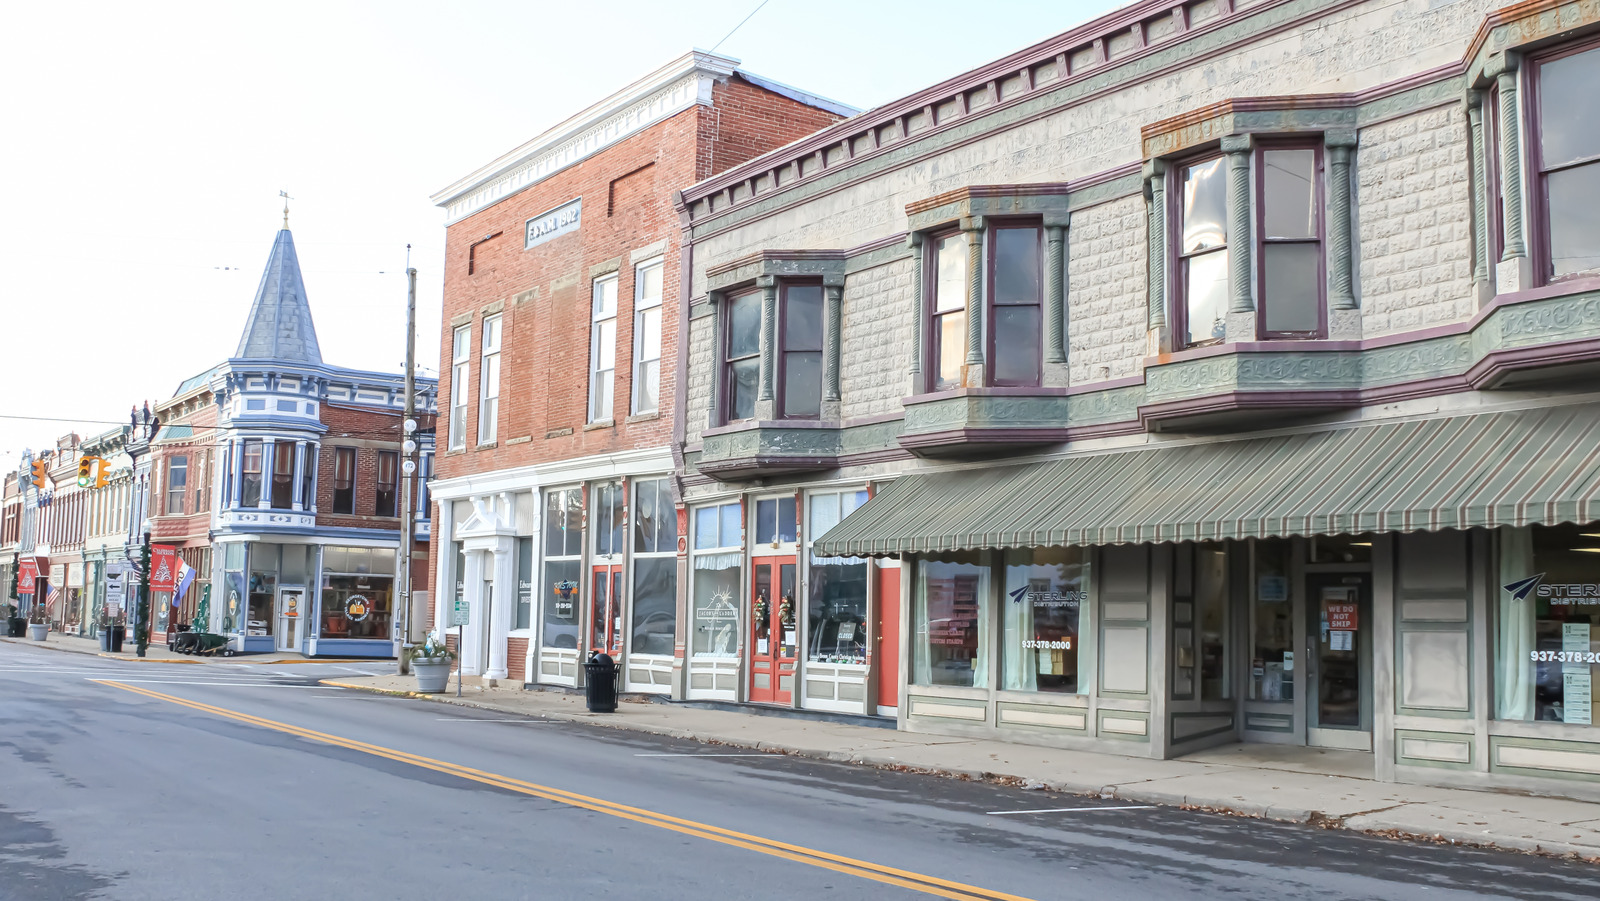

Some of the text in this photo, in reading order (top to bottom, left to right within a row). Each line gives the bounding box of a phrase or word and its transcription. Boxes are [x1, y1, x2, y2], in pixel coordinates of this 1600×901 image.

[1536, 583, 1600, 597] STER
[1026, 591, 1089, 601] STERLING
[1550, 597, 1600, 605] DISTRIB
[1328, 605, 1354, 613] WE DO
[1331, 620, 1351, 628] SHIP
[1021, 640, 1071, 650] 937-378-2000
